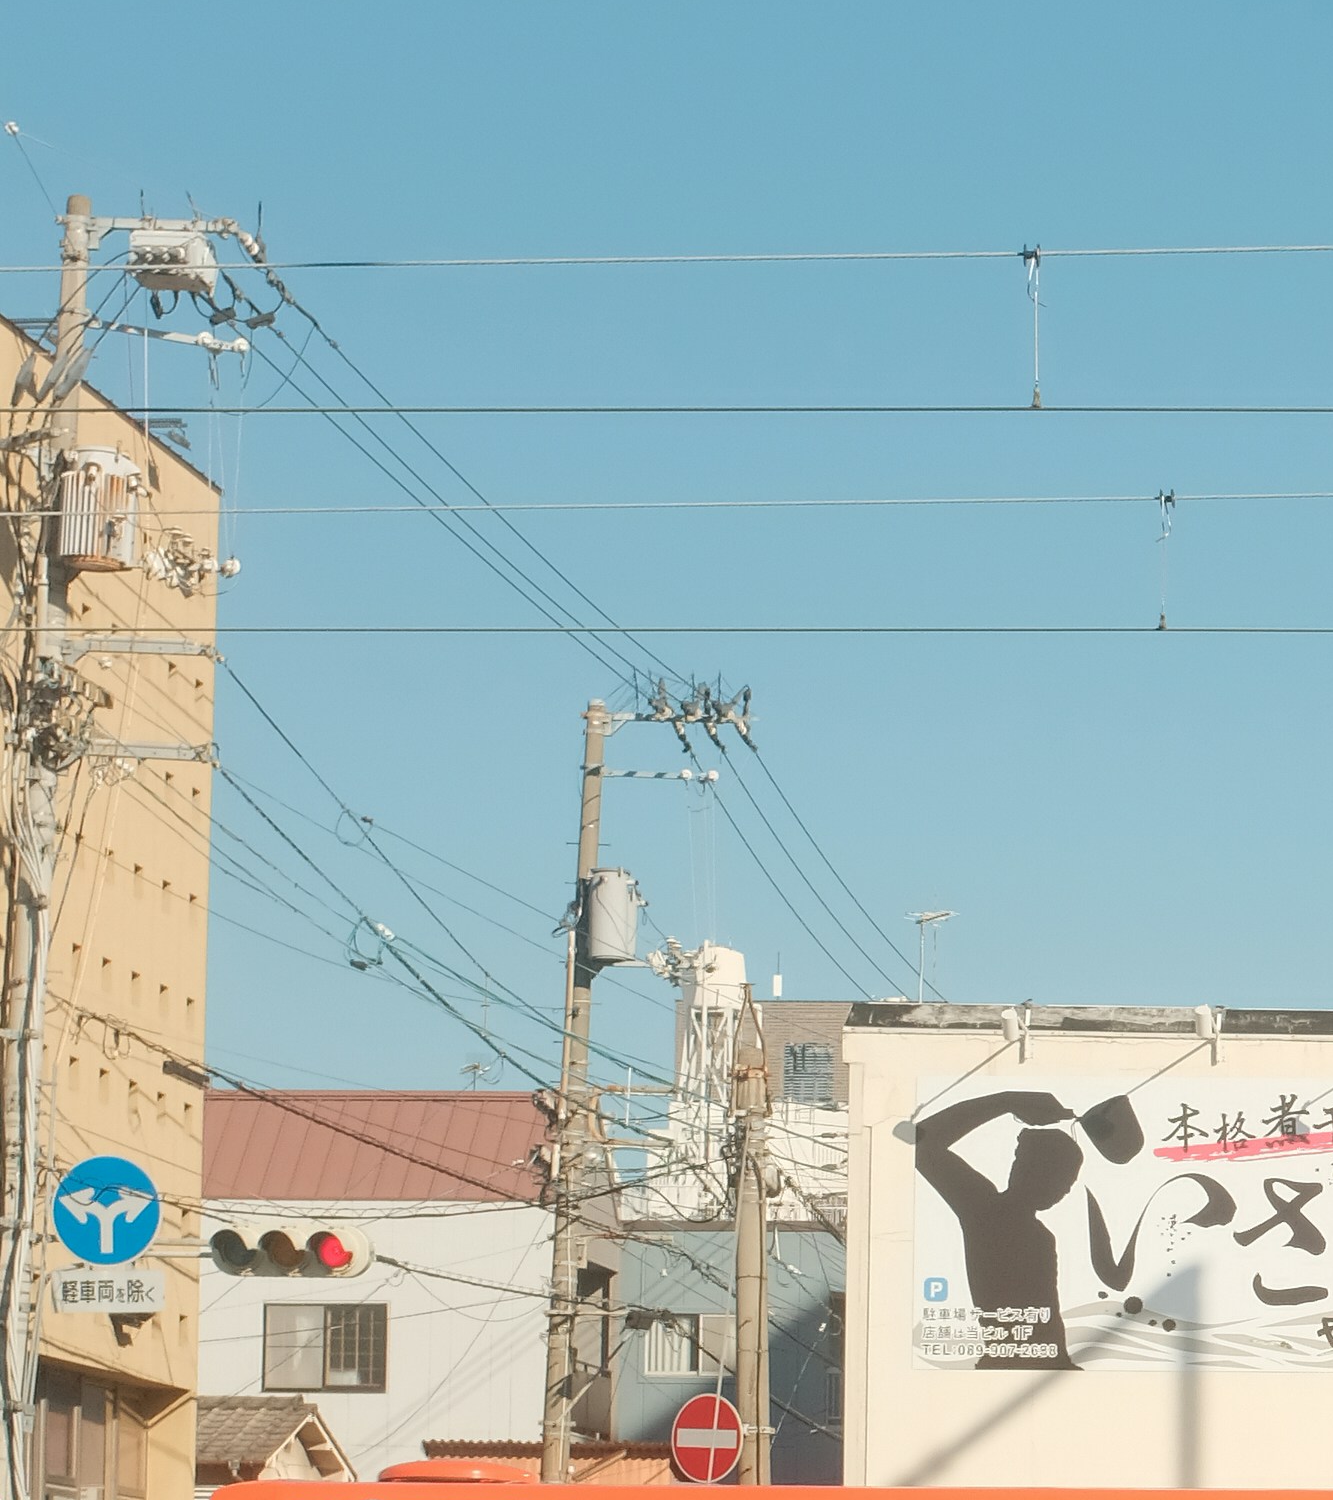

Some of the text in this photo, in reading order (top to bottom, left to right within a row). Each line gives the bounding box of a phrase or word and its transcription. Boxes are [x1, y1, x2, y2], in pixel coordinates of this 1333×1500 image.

[62, 1280, 155, 1303] 軽車両を除く
[930, 1282, 943, 1298] P
